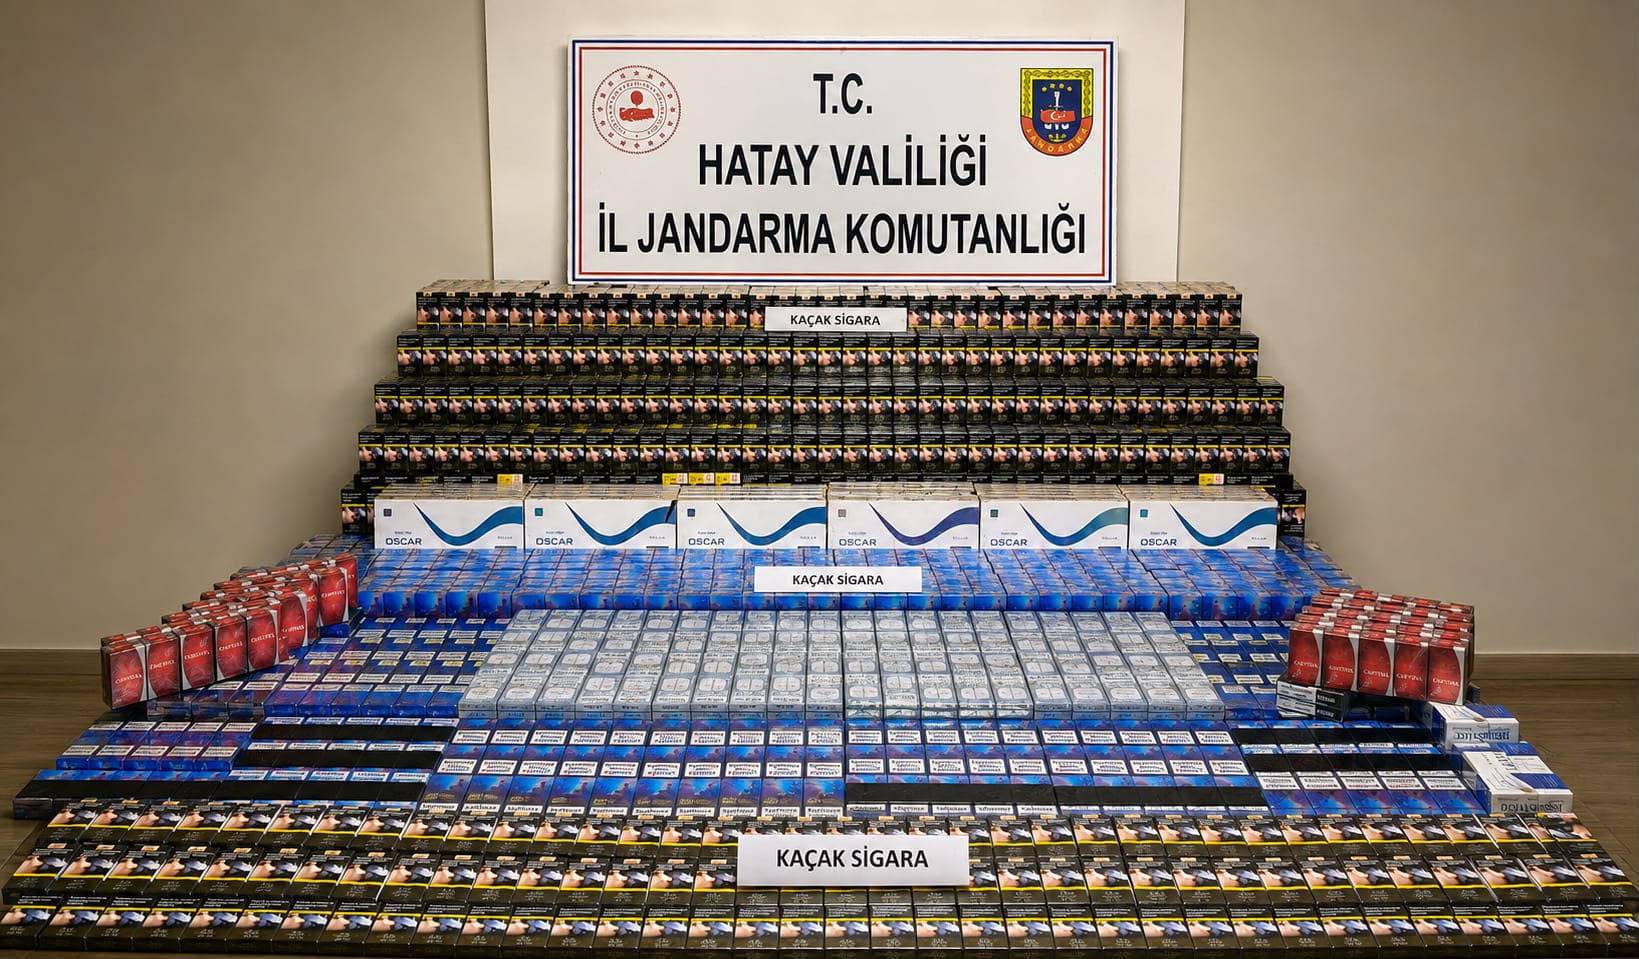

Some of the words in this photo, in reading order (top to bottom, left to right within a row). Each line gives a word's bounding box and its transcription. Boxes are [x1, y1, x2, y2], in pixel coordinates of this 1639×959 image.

[812, 73, 873, 115] T.C.
[699, 144, 819, 186] HATAY
[830, 134, 987, 187] VALİLİĞİ
[598, 202, 628, 253] İL
[638, 212, 836, 254] JANDARMA
[846, 203, 1085, 255] KOMUTANLIĞI
[790, 314, 831, 328] KAÇAK
[834, 312, 880, 326] SİGARA
[385, 537, 422, 546] OSCAR
[535, 537, 574, 546] OSCAR
[688, 537, 725, 546] OSCAR
[838, 538, 877, 547] OSCAR
[990, 538, 1028, 547] OSCAR
[1140, 538, 1177, 547] OSCAR
[792, 574, 833, 588] KAÇAK
[837, 572, 884, 586] SİGARA
[776, 848, 846, 872] KAÇAK
[851, 845, 929, 868] SİGARA
